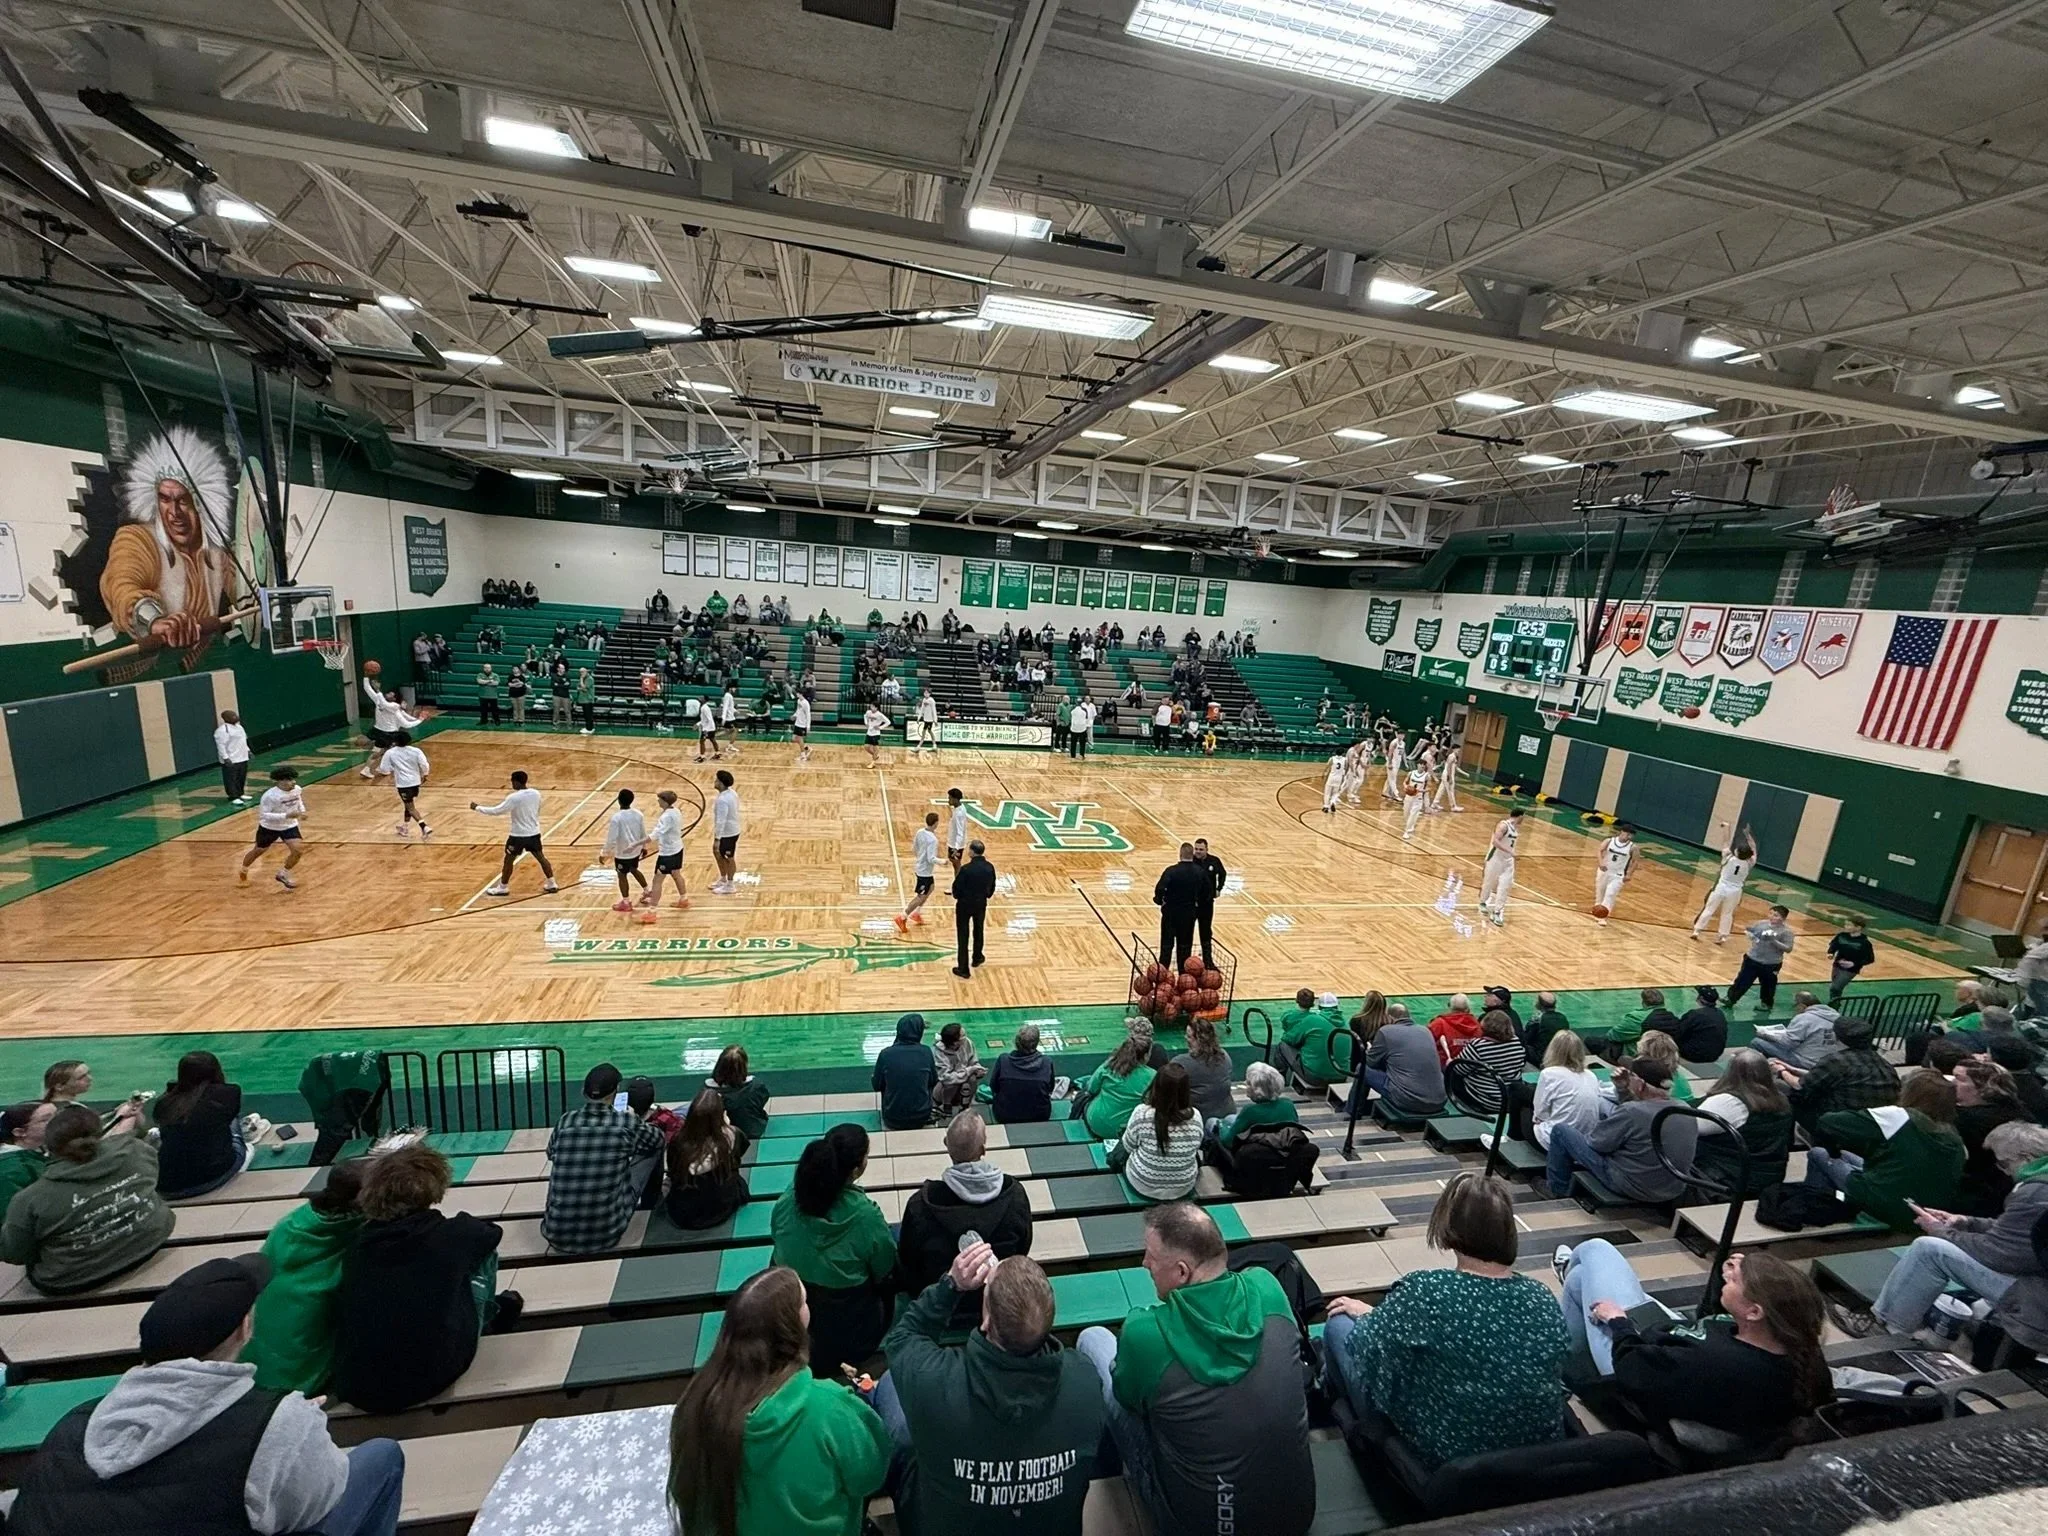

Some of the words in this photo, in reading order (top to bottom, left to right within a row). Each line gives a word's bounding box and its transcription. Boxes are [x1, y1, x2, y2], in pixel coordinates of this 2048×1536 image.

[860, 360, 888, 372] Memory
[898, 366, 914, 374] Sam
[921, 370, 937, 379] Judy
[938, 372, 976, 383] Greenawalt
[808, 366, 910, 392] WARRIOR
[920, 380, 974, 400] PRIDE
[1504, 604, 1568, 620] WARRIORS
[1667, 609, 1682, 617] BRANCH
[1776, 614, 1806, 625] ALLIANCE
[1820, 617, 1852, 627] MINERVA
[1517, 620, 1546, 636] 12:53
[1499, 642, 1508, 655] 0
[1649, 637, 1674, 649] WARRIORS
[1551, 647, 1562, 662] 0
[1722, 643, 1753, 656] WARRIORS
[1763, 649, 1796, 660] AVIATORS
[1490, 658, 1498, 669] 0
[1812, 655, 1838, 665] LIONS
[1636, 673, 1660, 682] BRANCH
[1667, 677, 1684, 685] WEST
[1684, 679, 1710, 688] BRANCH
[1719, 684, 1738, 692] WEST
[1738, 686, 1768, 697] BRANCH
[2016, 696, 2041, 705] 1998
[2010, 706, 2041, 714] STATE
[1734, 866, 1740, 875] 1
[570, 936, 794, 953] WARRIORS
[953, 1458, 975, 1479] WE
[979, 1461, 1014, 1482] PLAY
[1018, 1449, 1076, 1481] FOOTBALL
[970, 1484, 986, 1504] IN
[990, 1476, 1064, 1506] NOVEMBER!
[1217, 1474, 1234, 1536] GORY
